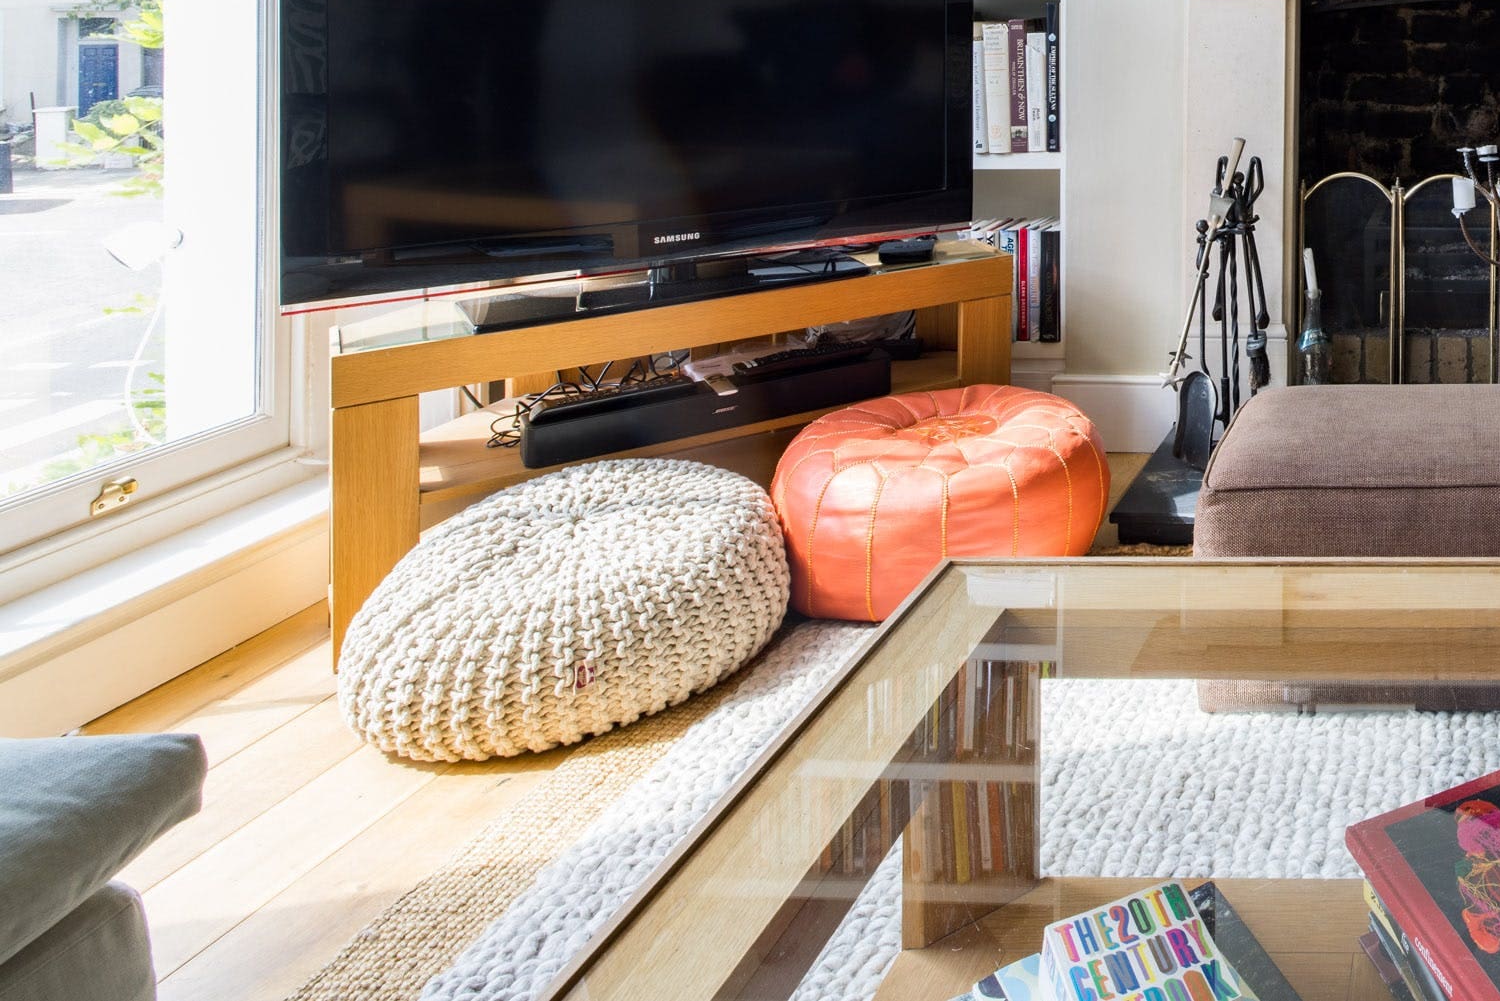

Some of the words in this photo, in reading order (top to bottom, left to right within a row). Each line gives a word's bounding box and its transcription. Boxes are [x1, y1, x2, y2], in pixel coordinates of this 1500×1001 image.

[654, 231, 701, 244] SAMSUNG
[1069, 919, 1214, 1001] CENTURY
[1414, 936, 1454, 998] confinement
